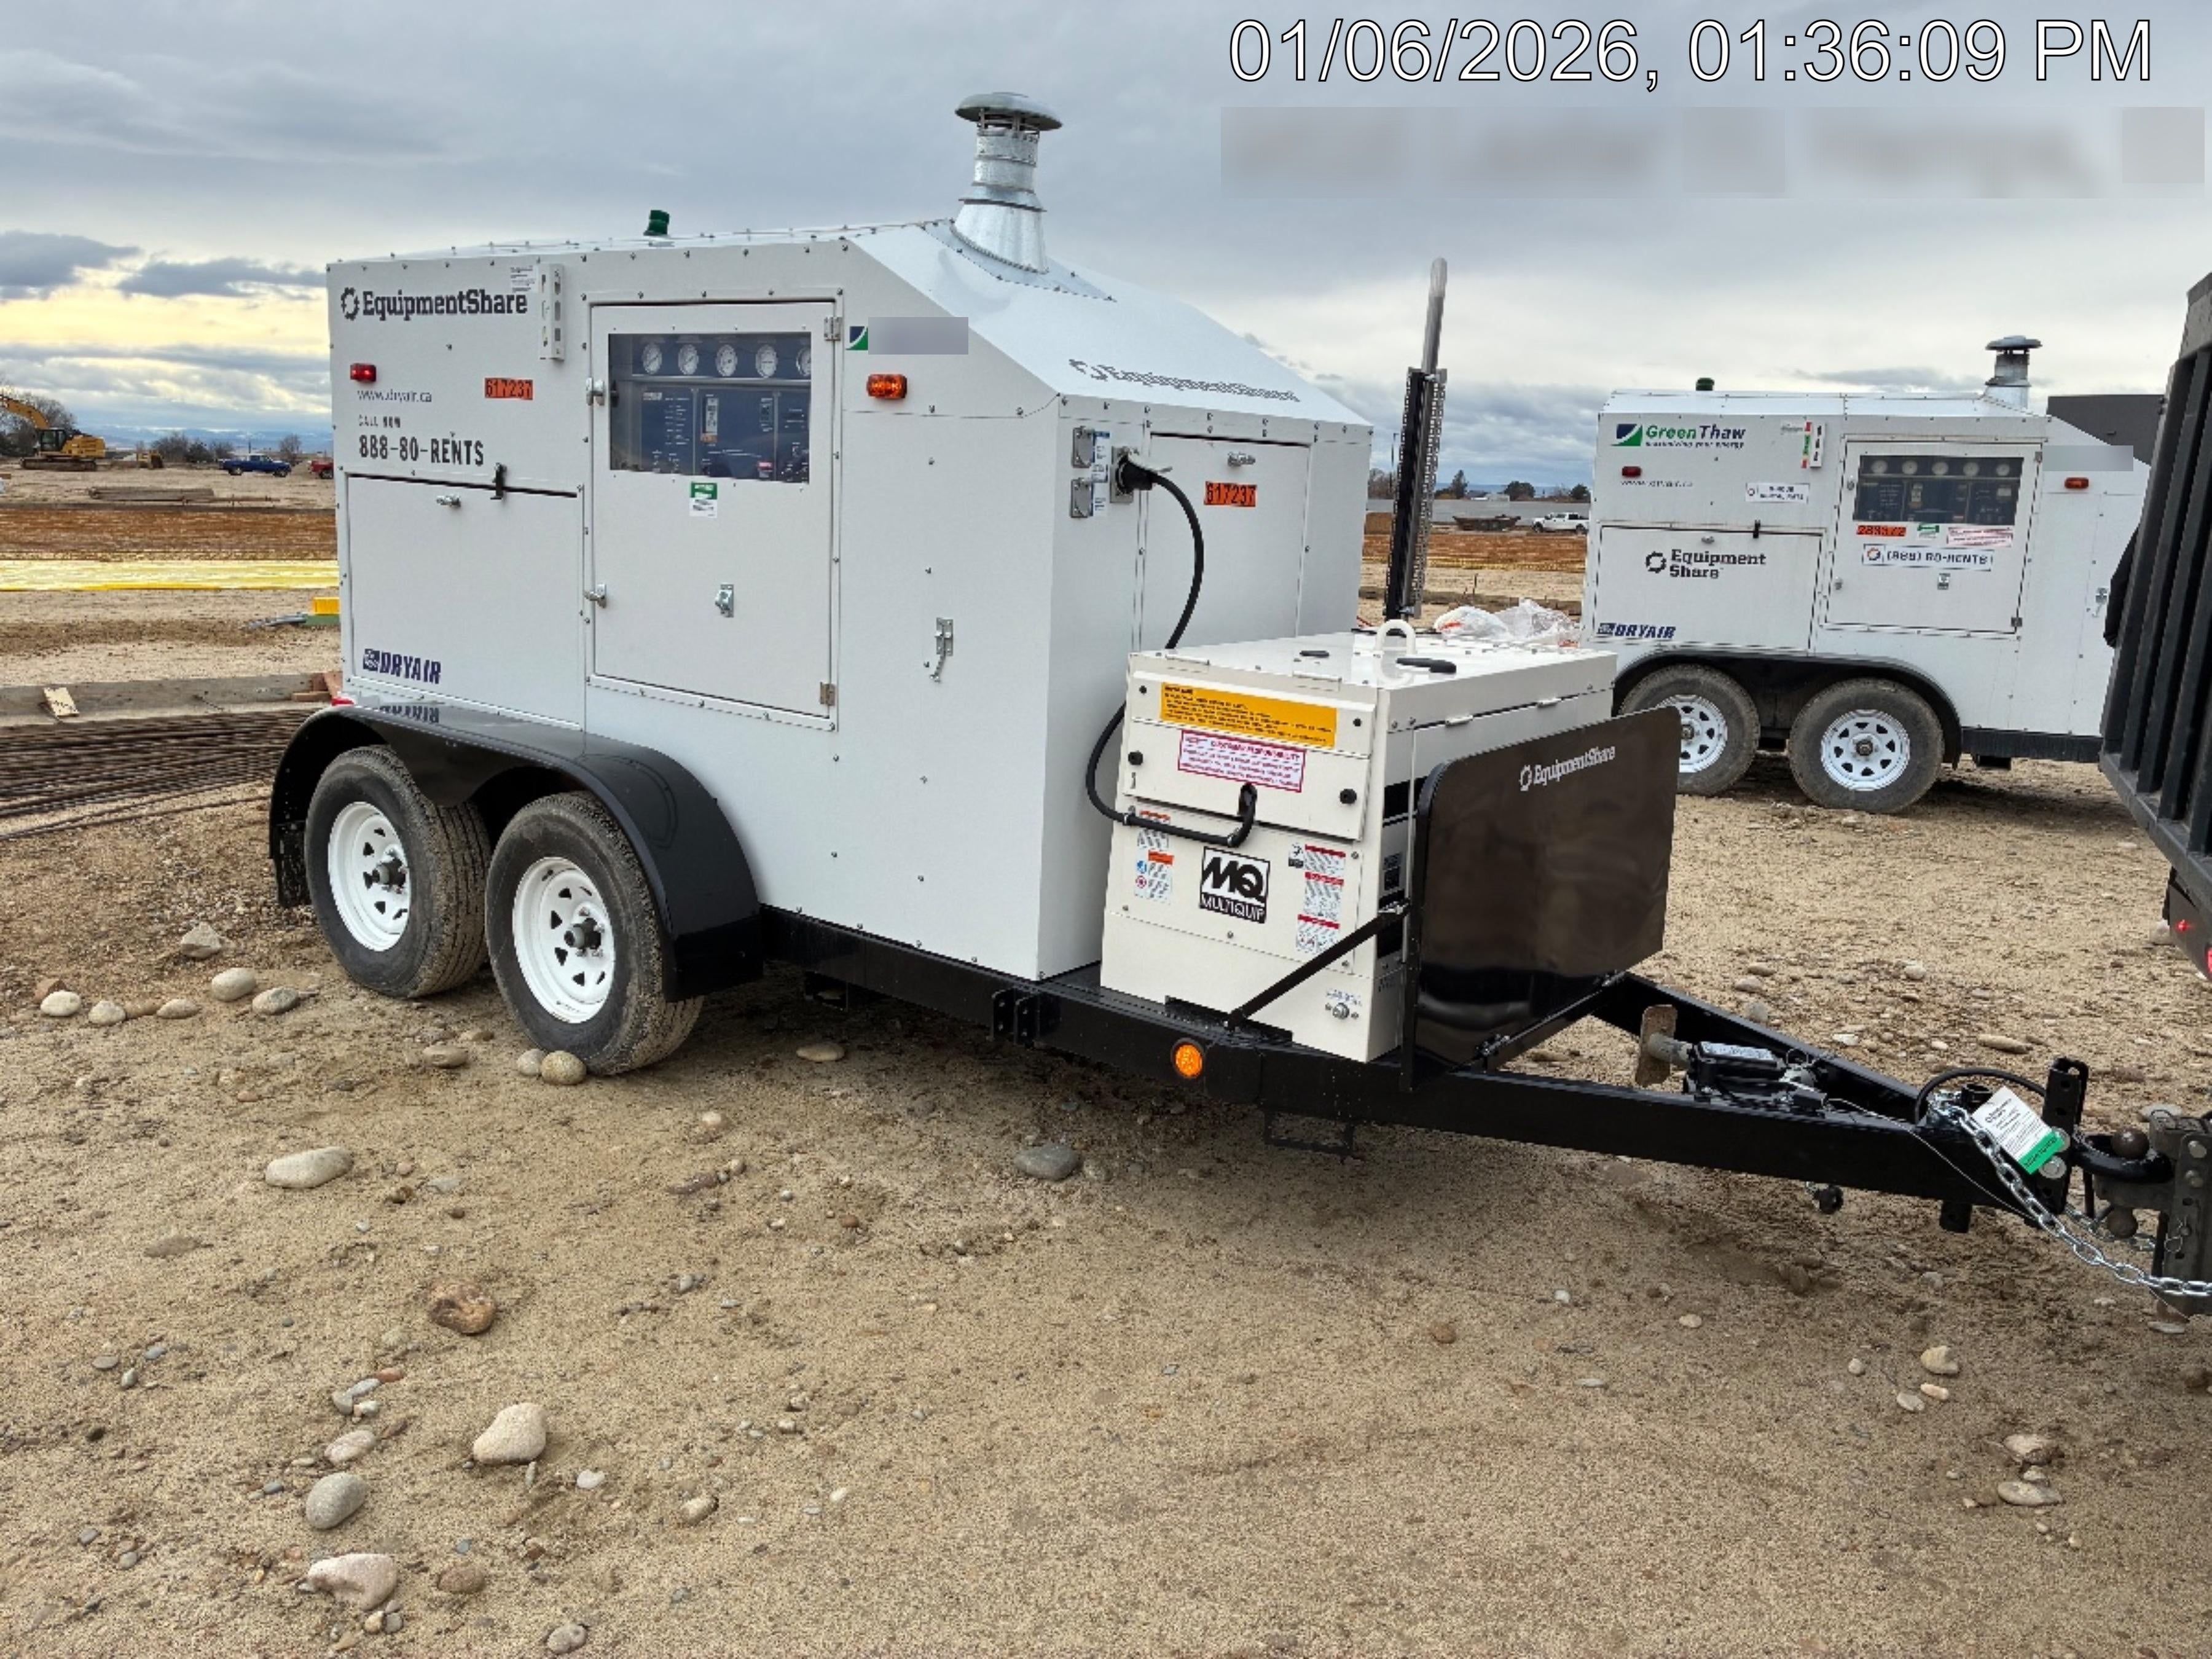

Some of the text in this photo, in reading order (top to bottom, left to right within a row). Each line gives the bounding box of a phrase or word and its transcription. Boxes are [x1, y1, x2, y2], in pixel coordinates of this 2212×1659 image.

[363, 289, 528, 321] EquipmentShare
[359, 434, 484, 466] 888-80-RENTS
[1206, 483, 1256, 506] 617237
[1670, 565, 1719, 579] Share
[1671, 549, 1766, 566] Equipment
[1615, 624, 1676, 638] DRYAIR
[380, 652, 441, 684] DRYAIR
[1534, 747, 1616, 786] EquipmentShare
[1202, 857, 1266, 904] MQ
